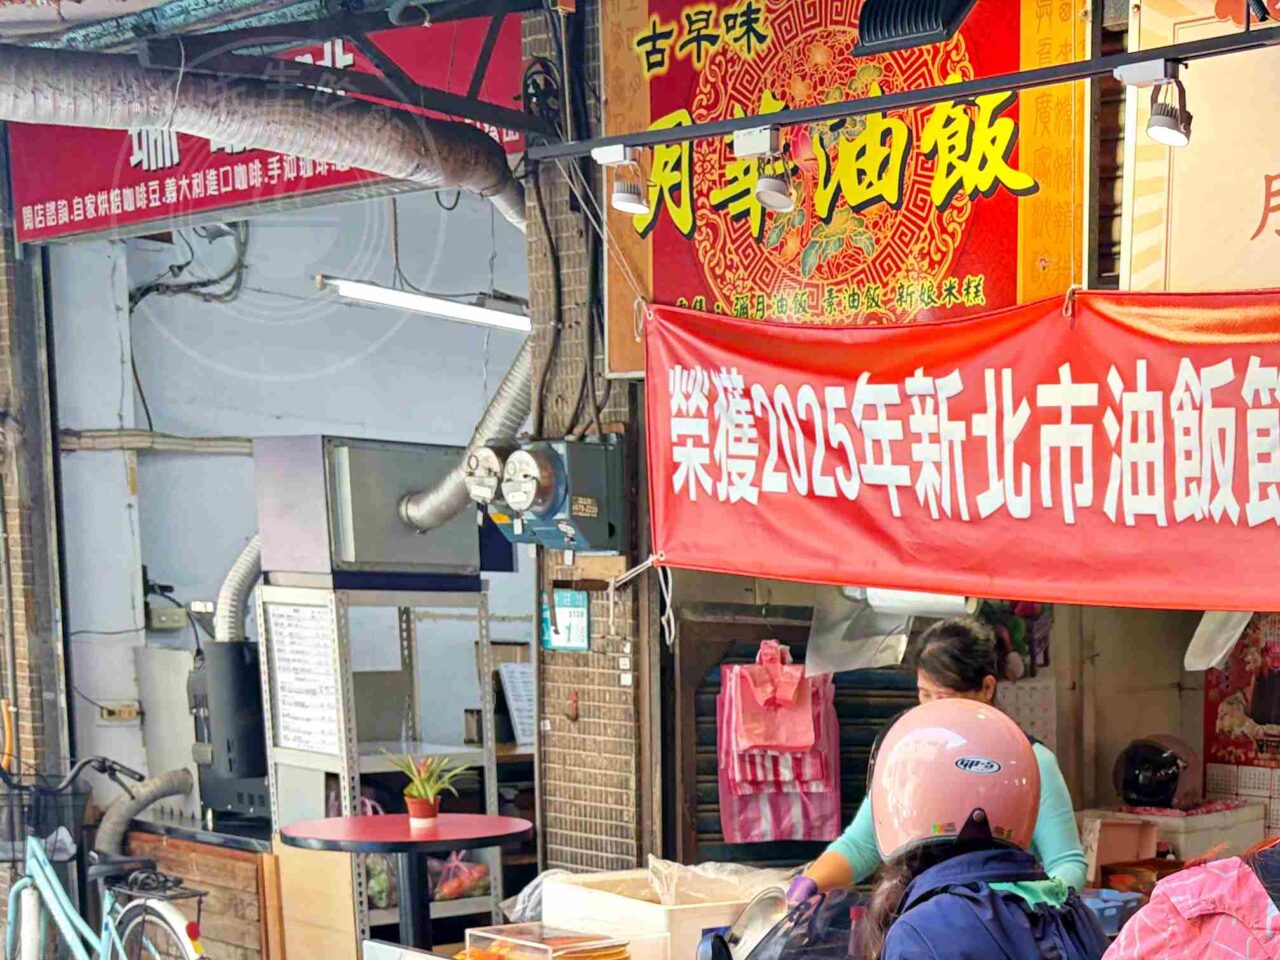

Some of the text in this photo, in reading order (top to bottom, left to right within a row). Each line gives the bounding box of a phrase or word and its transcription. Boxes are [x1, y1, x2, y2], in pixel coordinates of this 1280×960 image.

[637, 3, 768, 71] 古早味
[633, 74, 1040, 240] 月華油飯
[823, 285, 882, 313] 素油飯
[896, 277, 985, 308] 新娘米糕
